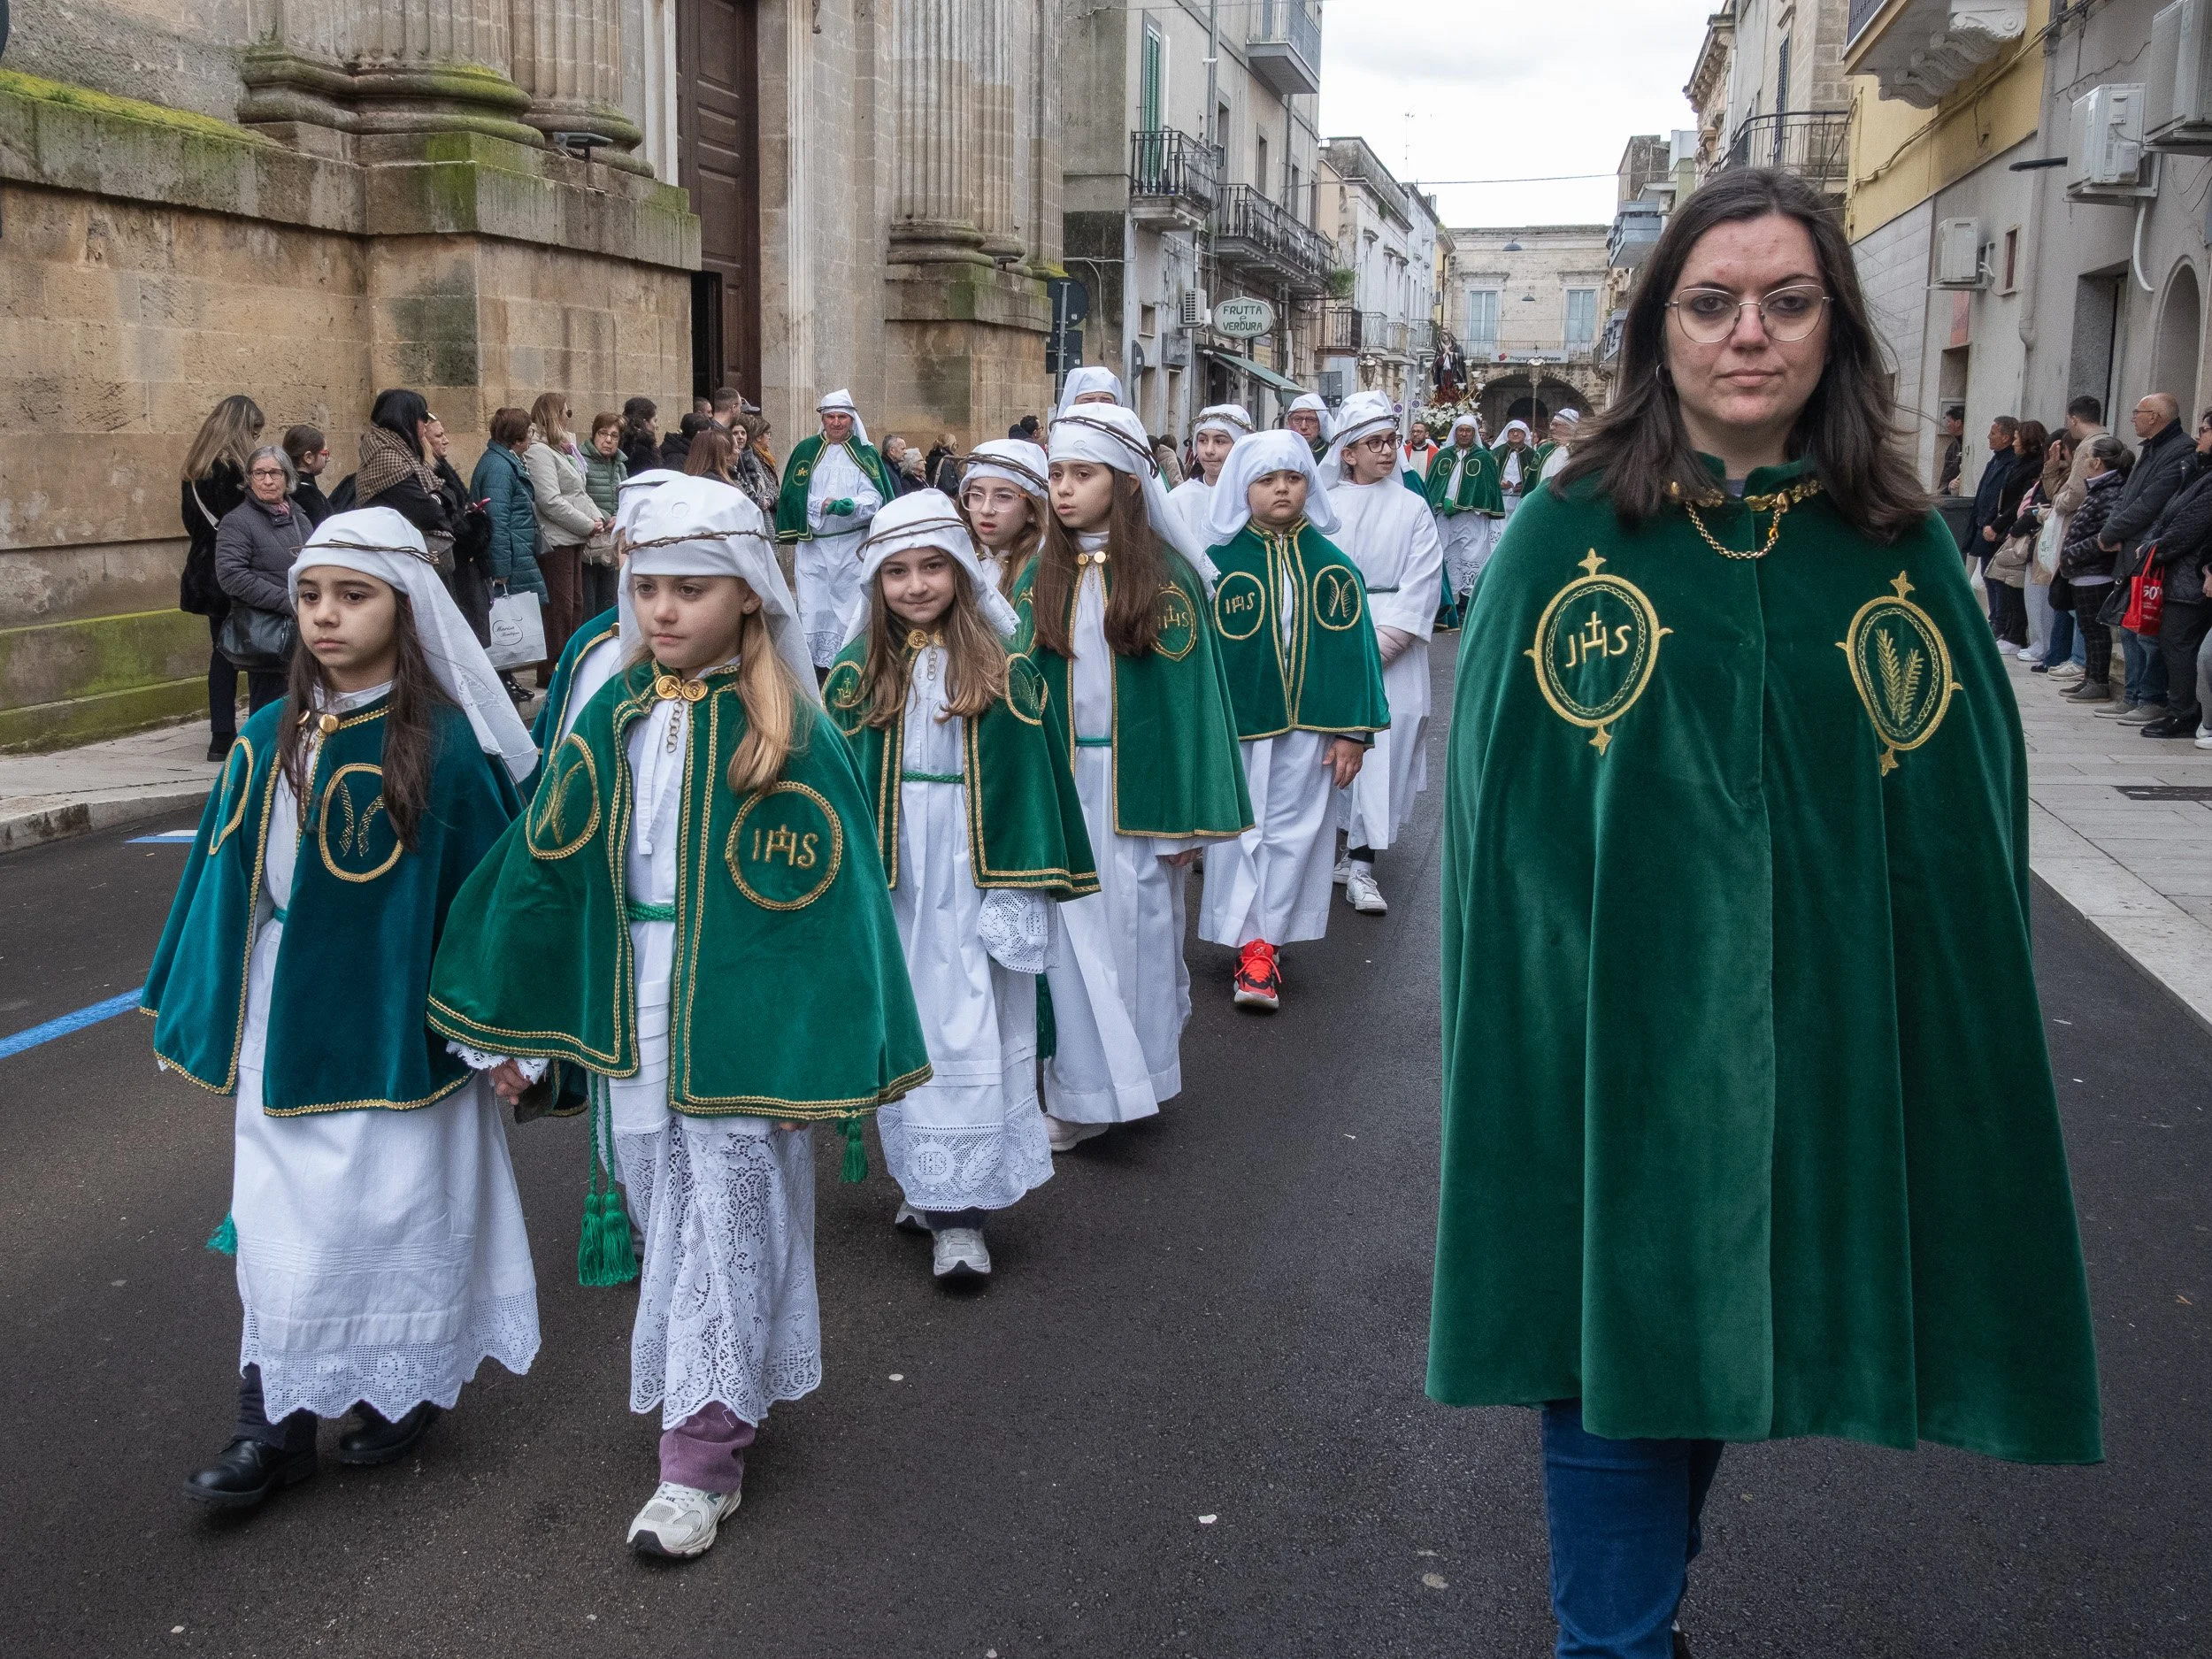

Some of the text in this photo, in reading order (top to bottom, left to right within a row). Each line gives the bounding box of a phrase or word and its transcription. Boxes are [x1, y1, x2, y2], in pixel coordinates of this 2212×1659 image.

[1223, 305, 1263, 315] FRUTTA
[1223, 321, 1263, 331] VERDURA
[752, 824, 818, 868] IHS
